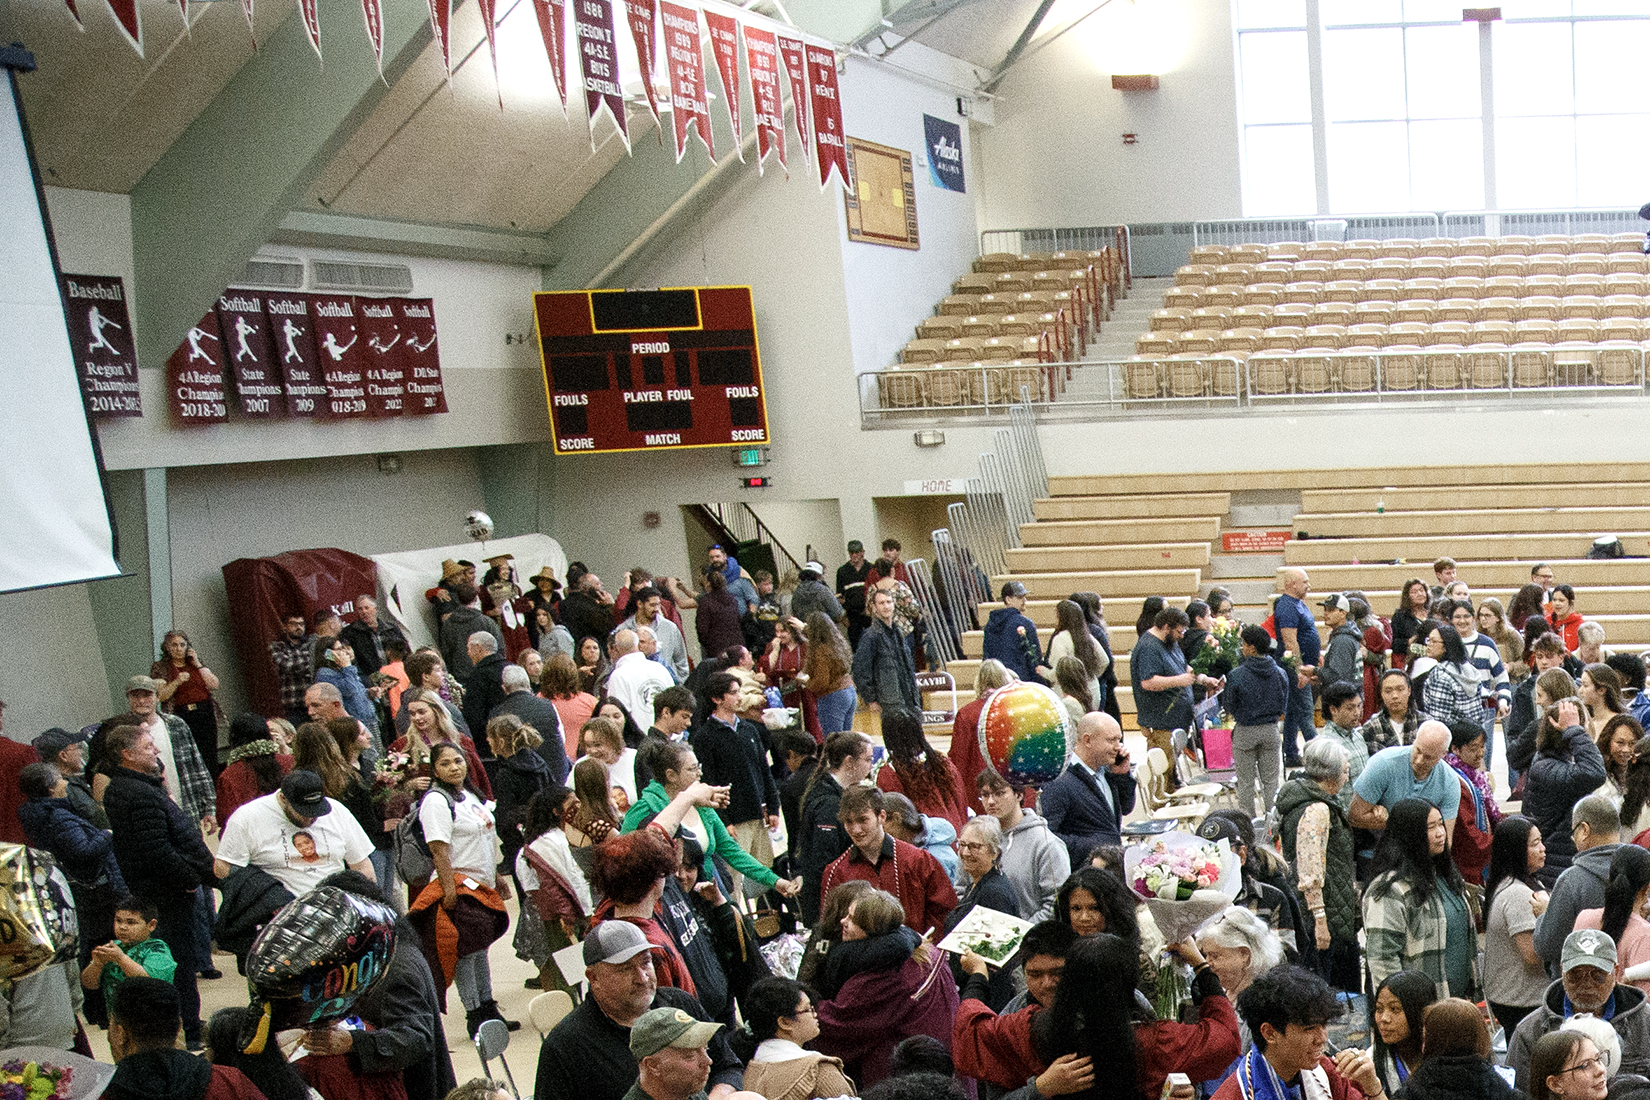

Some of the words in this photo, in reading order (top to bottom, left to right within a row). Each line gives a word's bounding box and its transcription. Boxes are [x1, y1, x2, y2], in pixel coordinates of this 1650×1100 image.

[67, 280, 122, 300] Baseball
[220, 296, 261, 313] Softball
[268, 299, 307, 315] Softball
[316, 302, 354, 318] Softball
[363, 305, 393, 318] Softball
[632, 341, 671, 354] PERIOD
[86, 361, 124, 377] Region
[124, 362, 133, 375] V
[623, 390, 663, 403] PLAYER
[667, 389, 694, 401] FOUL
[725, 386, 759, 398] FOULS
[554, 393, 589, 406] FOULS
[645, 433, 681, 446] MATCH
[731, 428, 765, 441] SCORE
[560, 437, 594, 450] SCORE
[921, 480, 952, 492] HOME
[915, 676, 946, 687] KAYHI
[924, 714, 945, 722] INGS
